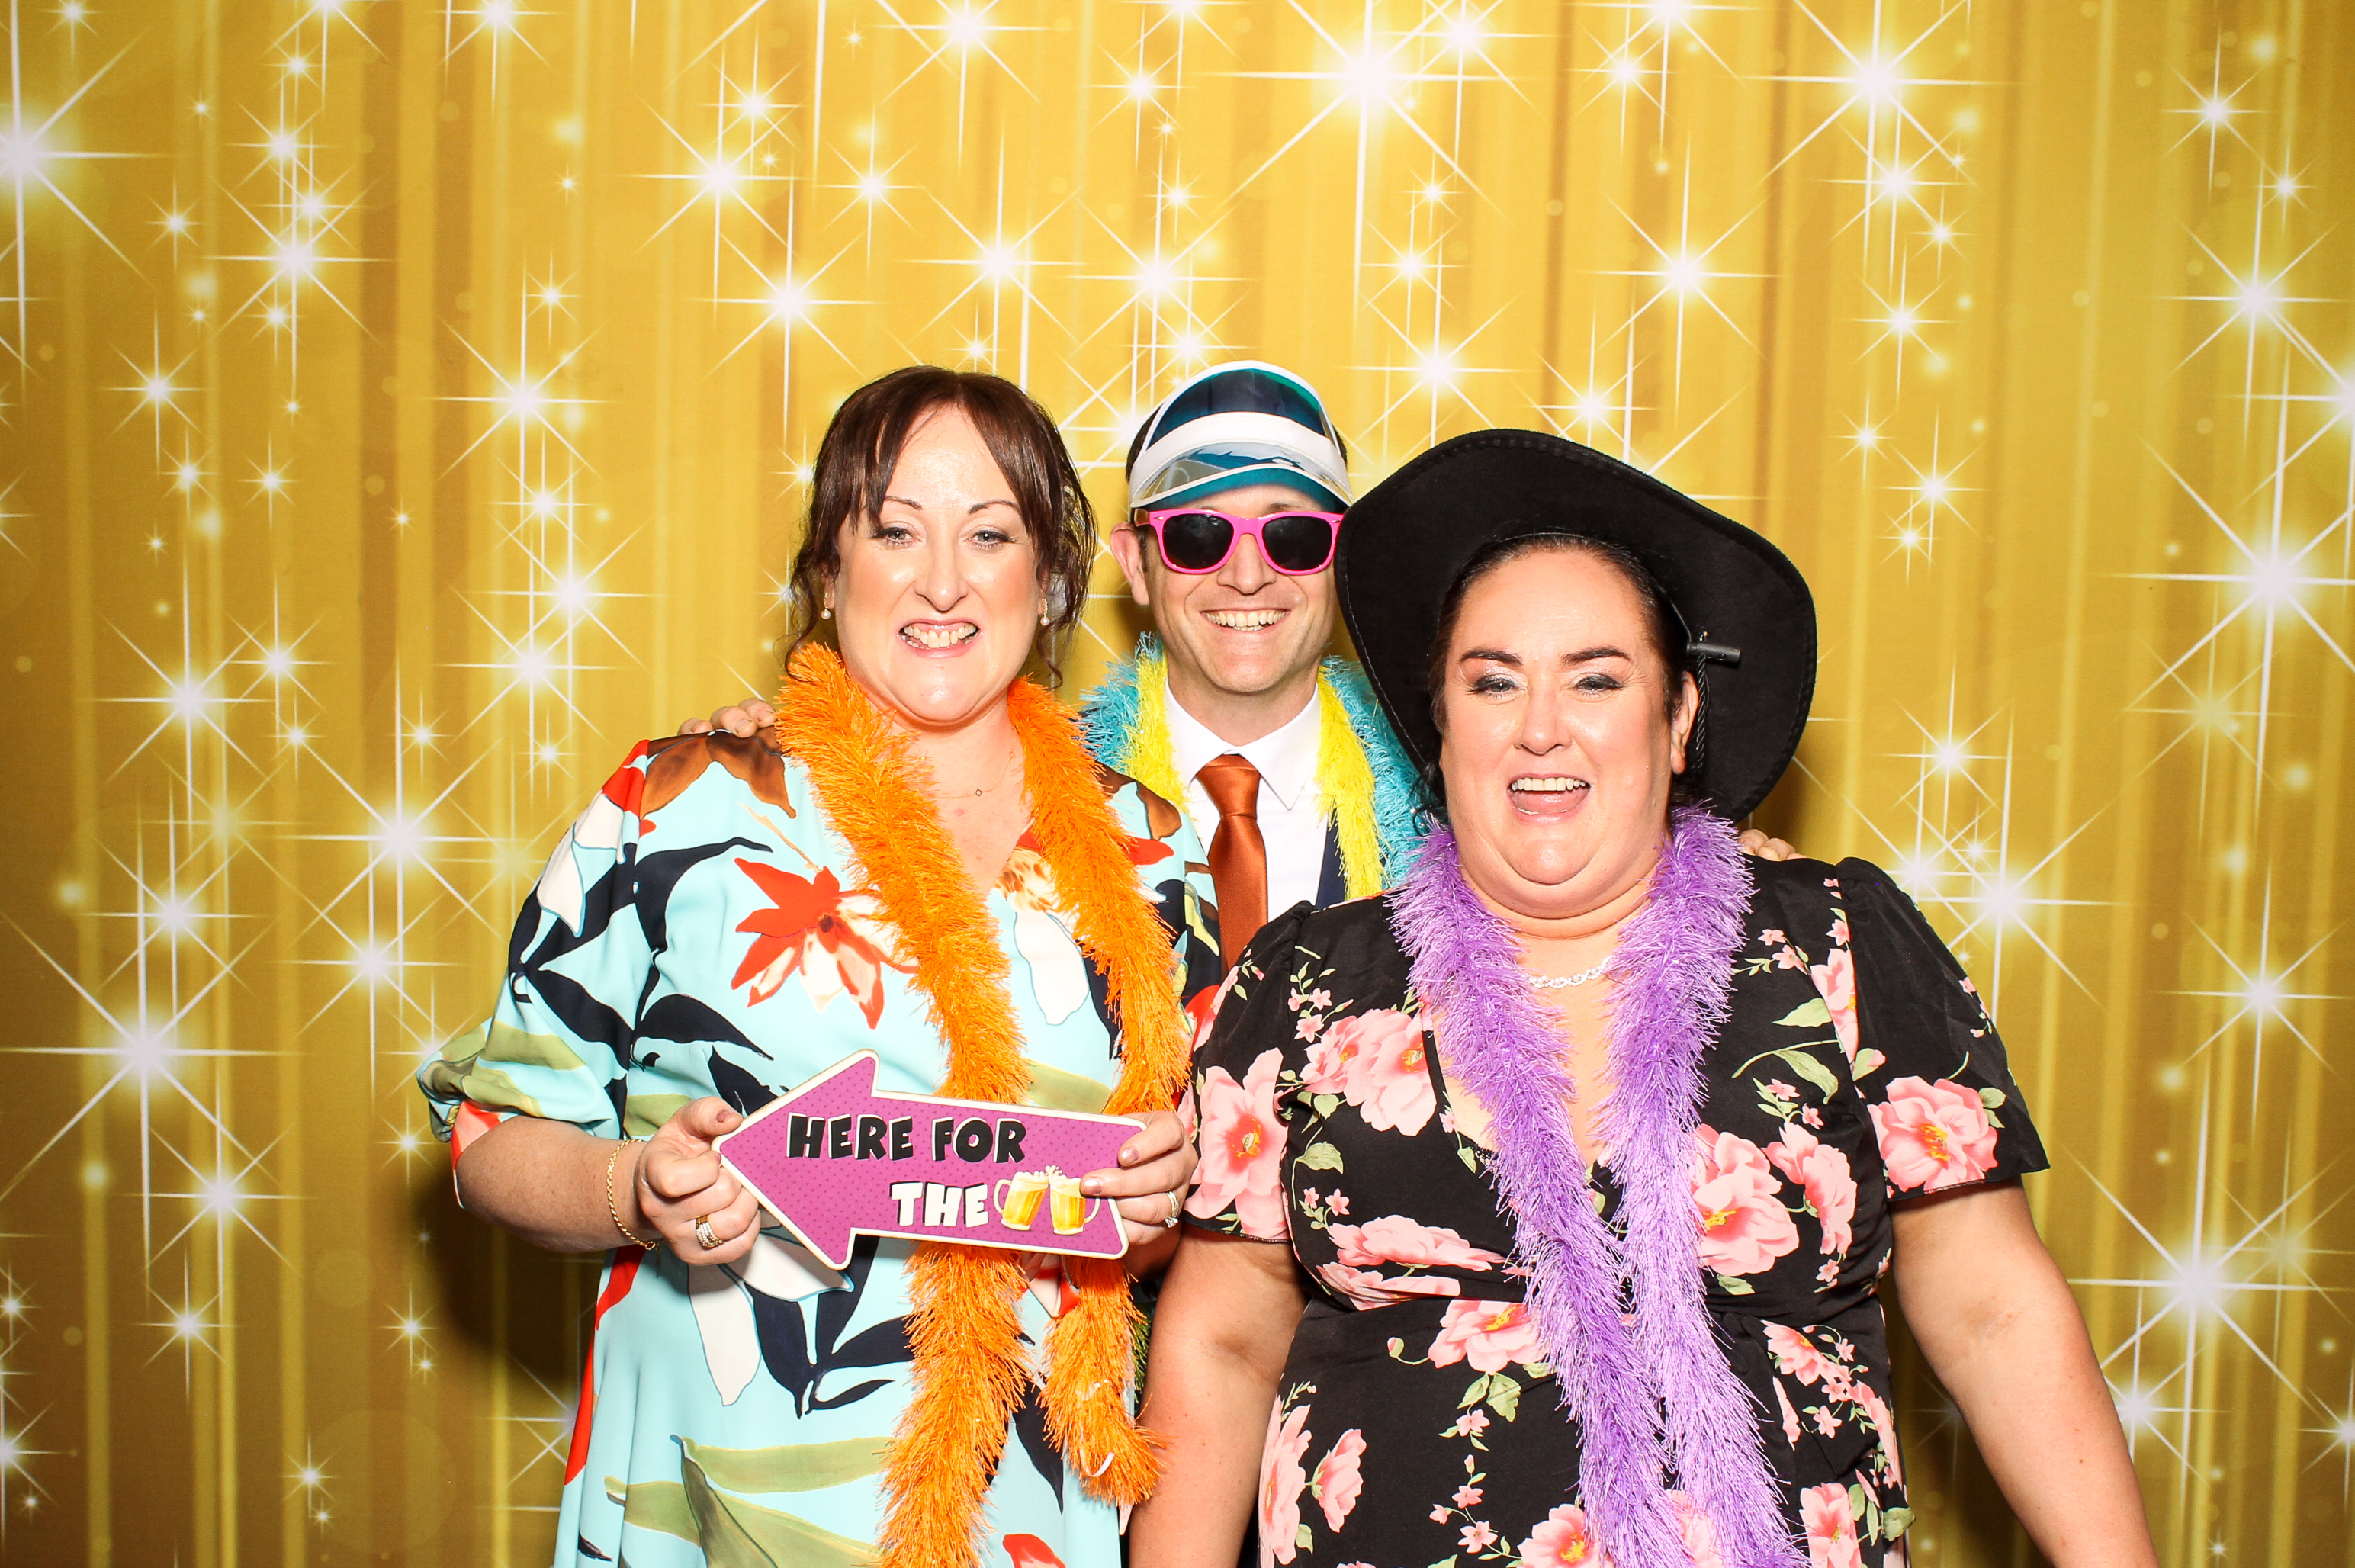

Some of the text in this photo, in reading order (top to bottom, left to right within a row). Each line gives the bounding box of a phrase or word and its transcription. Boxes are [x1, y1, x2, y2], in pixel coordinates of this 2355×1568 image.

[786, 1112, 1026, 1164] HERE FOR
[889, 1181, 988, 1228] THE
